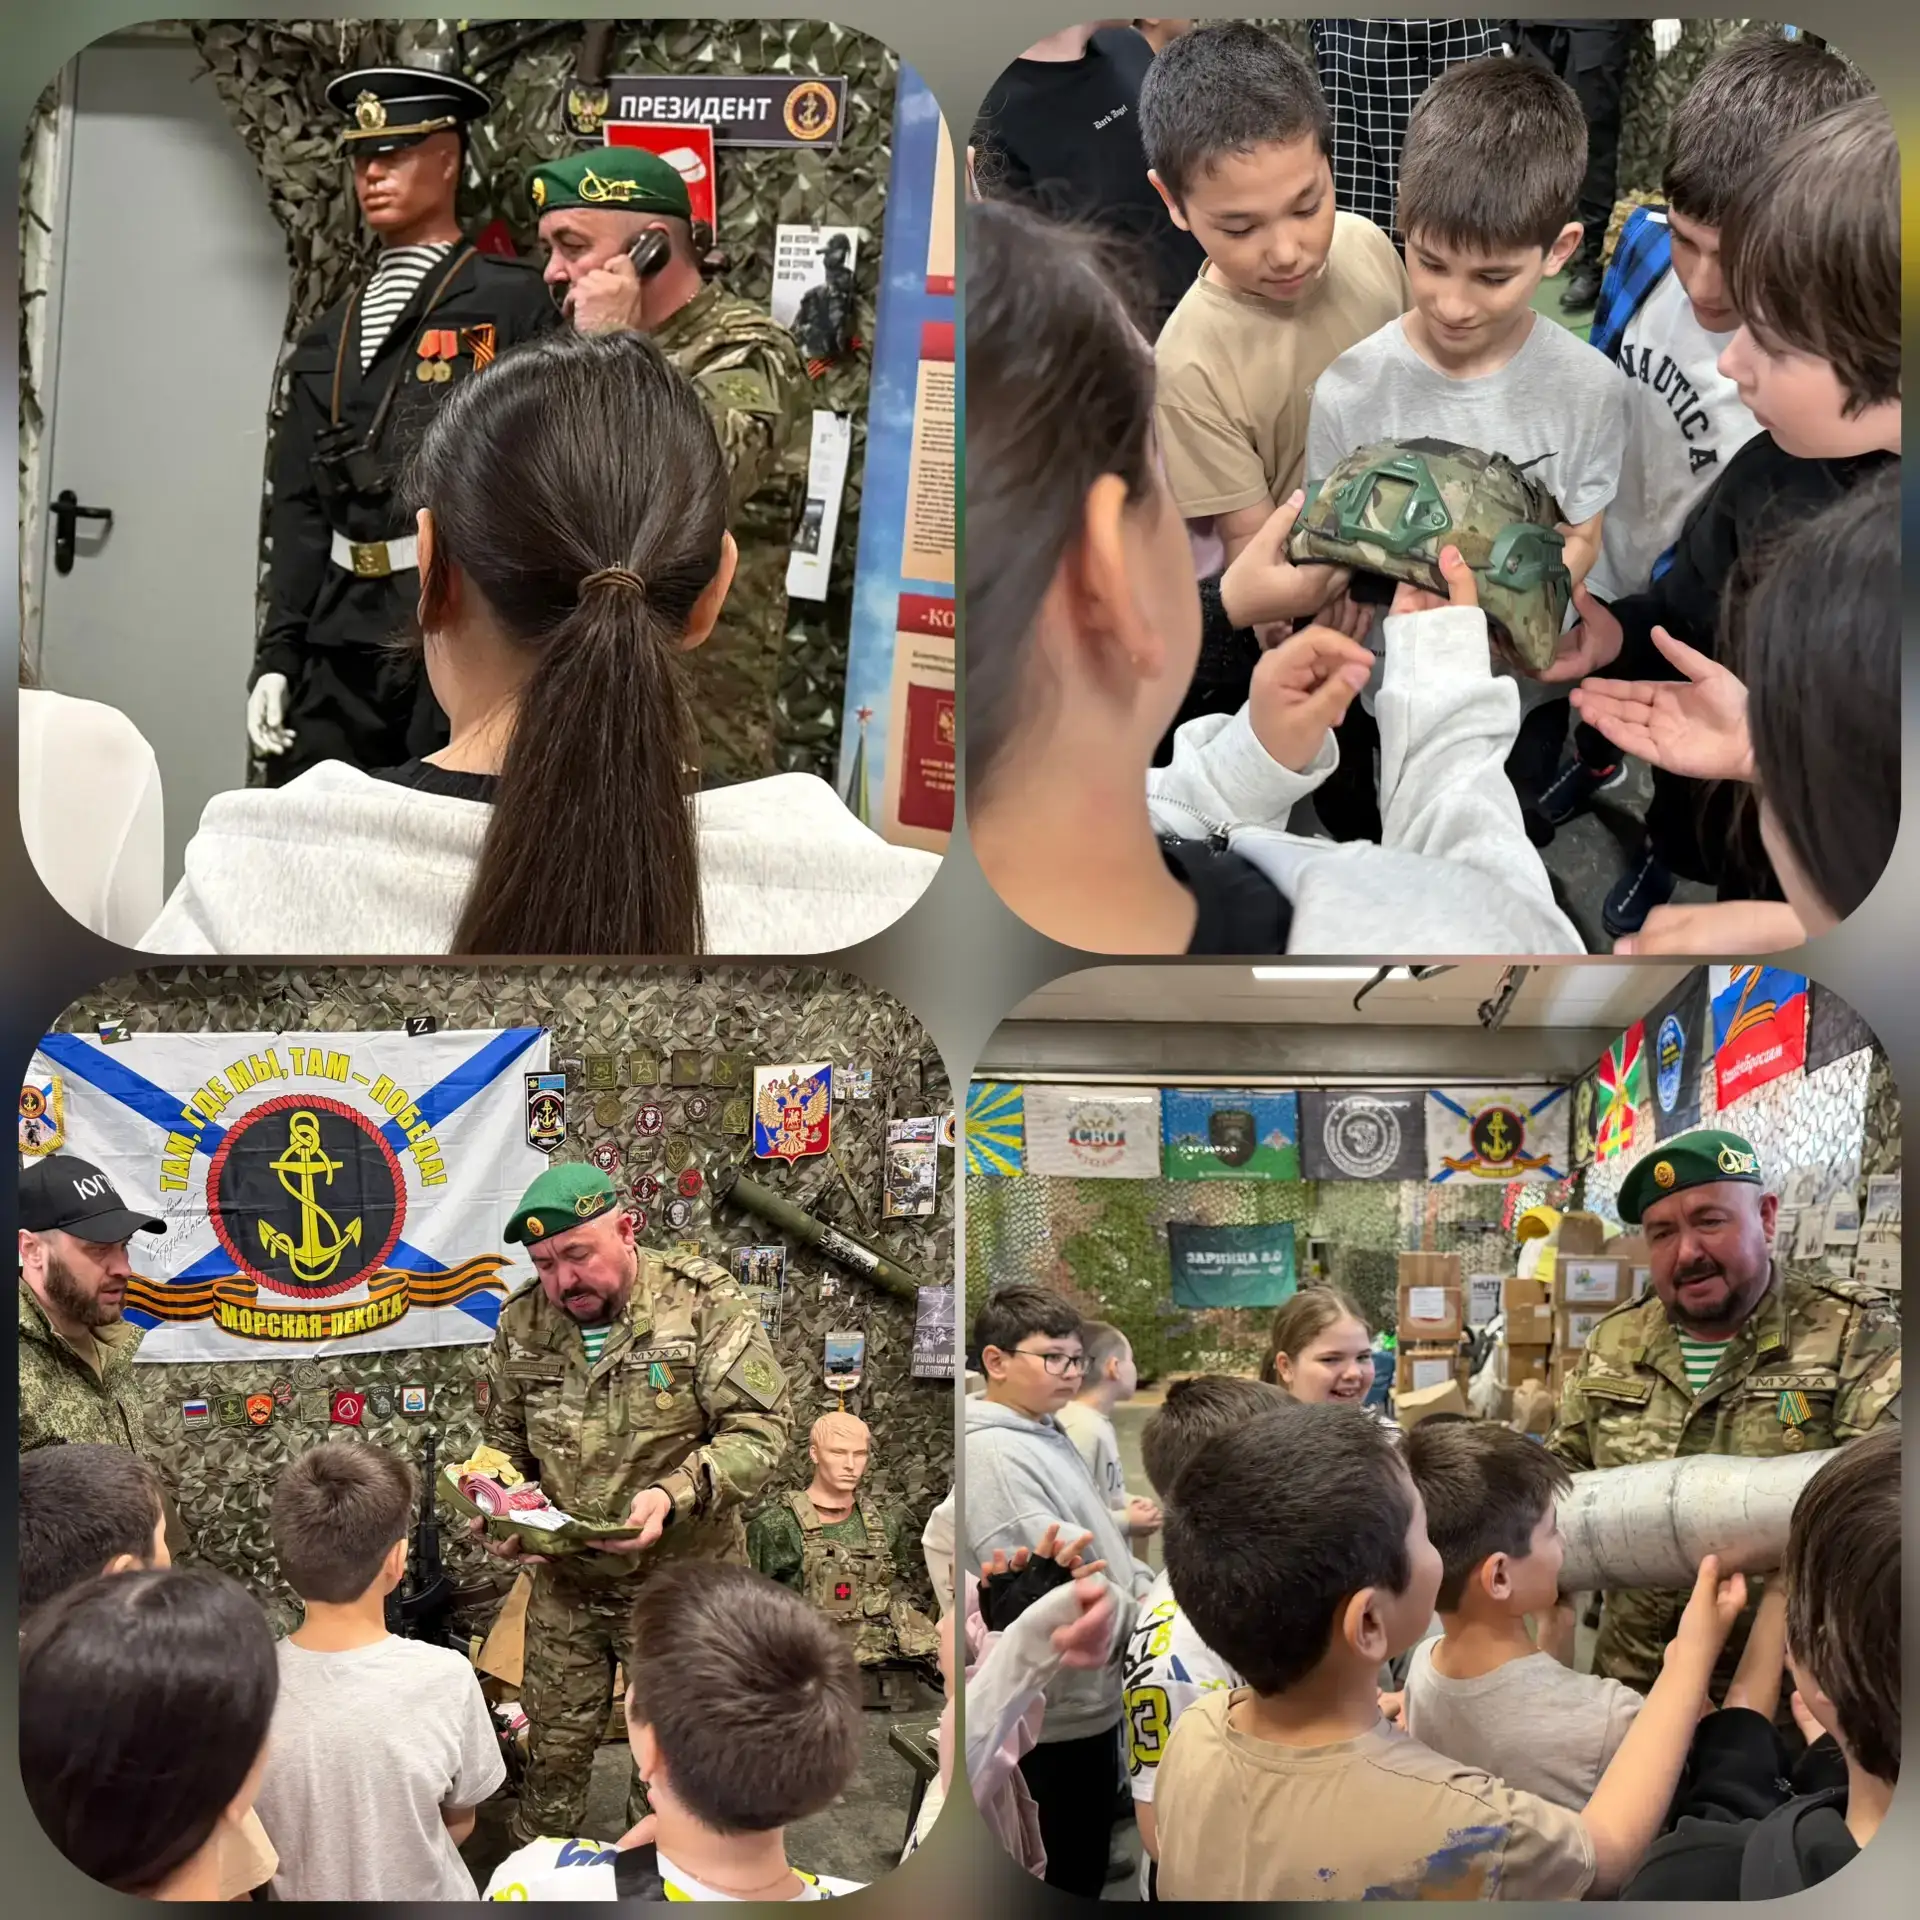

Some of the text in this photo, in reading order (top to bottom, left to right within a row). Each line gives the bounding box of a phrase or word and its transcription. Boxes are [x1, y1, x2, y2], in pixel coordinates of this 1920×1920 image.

[619, 96, 771, 124] ПРЕЗИДЕНТ
[1616, 344, 1718, 475] NAUTICA
[413, 1018, 428, 1033] Z
[224, 1048, 289, 1095] МЫ,
[288, 1046, 350, 1083] ТАМ
[180, 1076, 235, 1131] ГДЕ
[368, 1073, 448, 1187] ПОБЕДА!
[160, 1131, 202, 1192] ТАМ,
[220, 1293, 402, 1338] МОРСКАЯ ПЕХОТА
[631, 1348, 682, 1361] МУХА
[1756, 1376, 1827, 1388] МУХА
